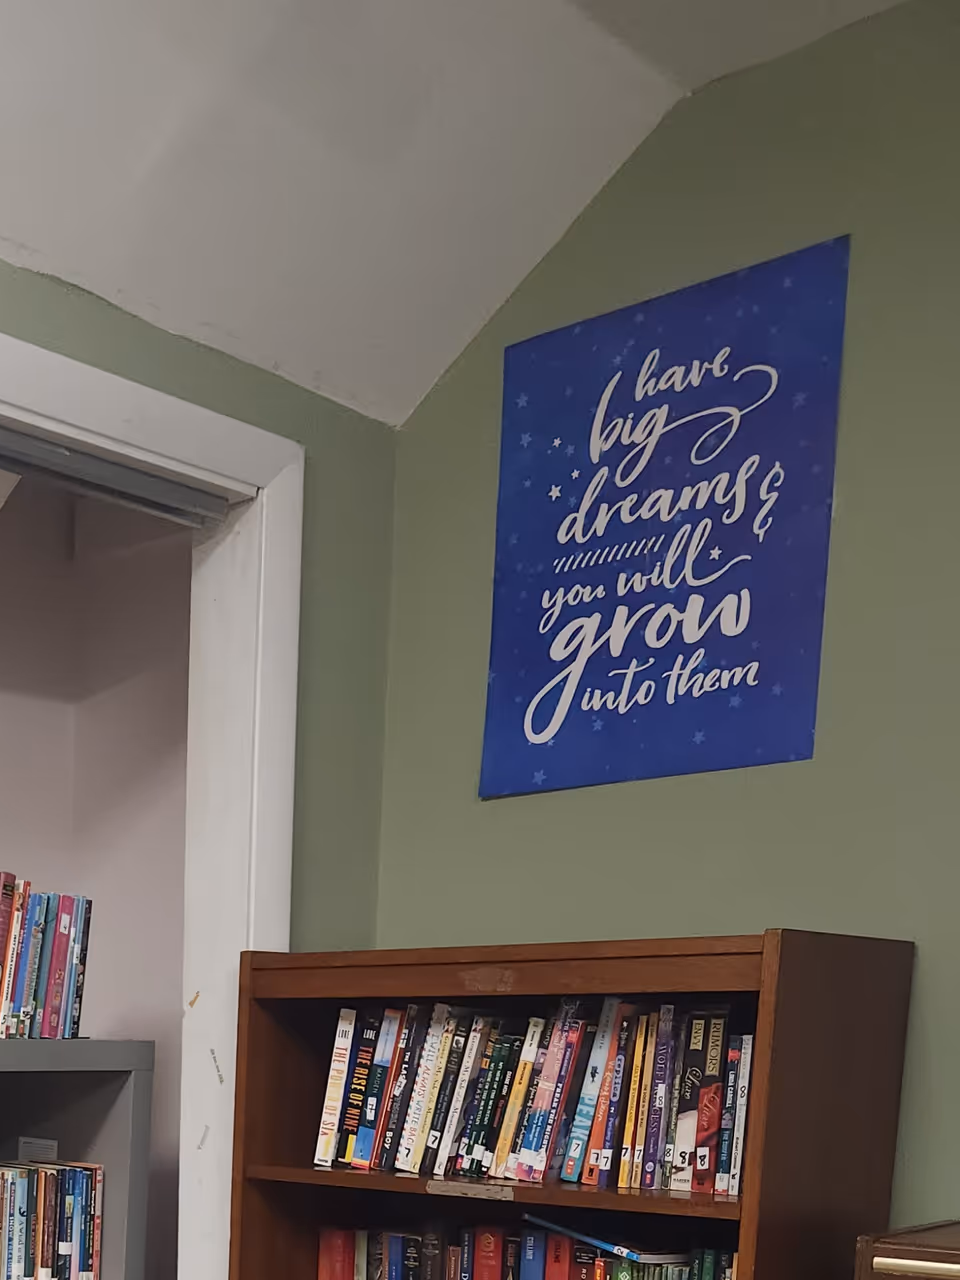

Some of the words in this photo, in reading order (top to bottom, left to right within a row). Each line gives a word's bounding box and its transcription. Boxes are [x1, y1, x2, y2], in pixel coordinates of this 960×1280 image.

[557, 455, 760, 543] dreams
[753, 461, 785, 543] &
[539, 584, 606, 634] you
[617, 518, 752, 596] will
[524, 588, 751, 744] grow
[581, 658, 655, 714] into
[662, 648, 759, 705] them
[692, 1022, 702, 1047] ENVY
[333, 1047, 348, 1065] THE
[359, 1047, 373, 1065] THE
[425, 1040, 438, 1063] WILL
[707, 1022, 721, 1073] RUMORS
[351, 1067, 368, 1090] RISE
[417, 1065, 435, 1098] ALWAYS
[612, 1056, 623, 1101] replica
[683, 1067, 702, 1100] Luxe
[349, 1093, 363, 1105] OF
[344, 1107, 359, 1131] NINE
[411, 1100, 424, 1124] WRITE
[384, 1131, 393, 1150] BOY
